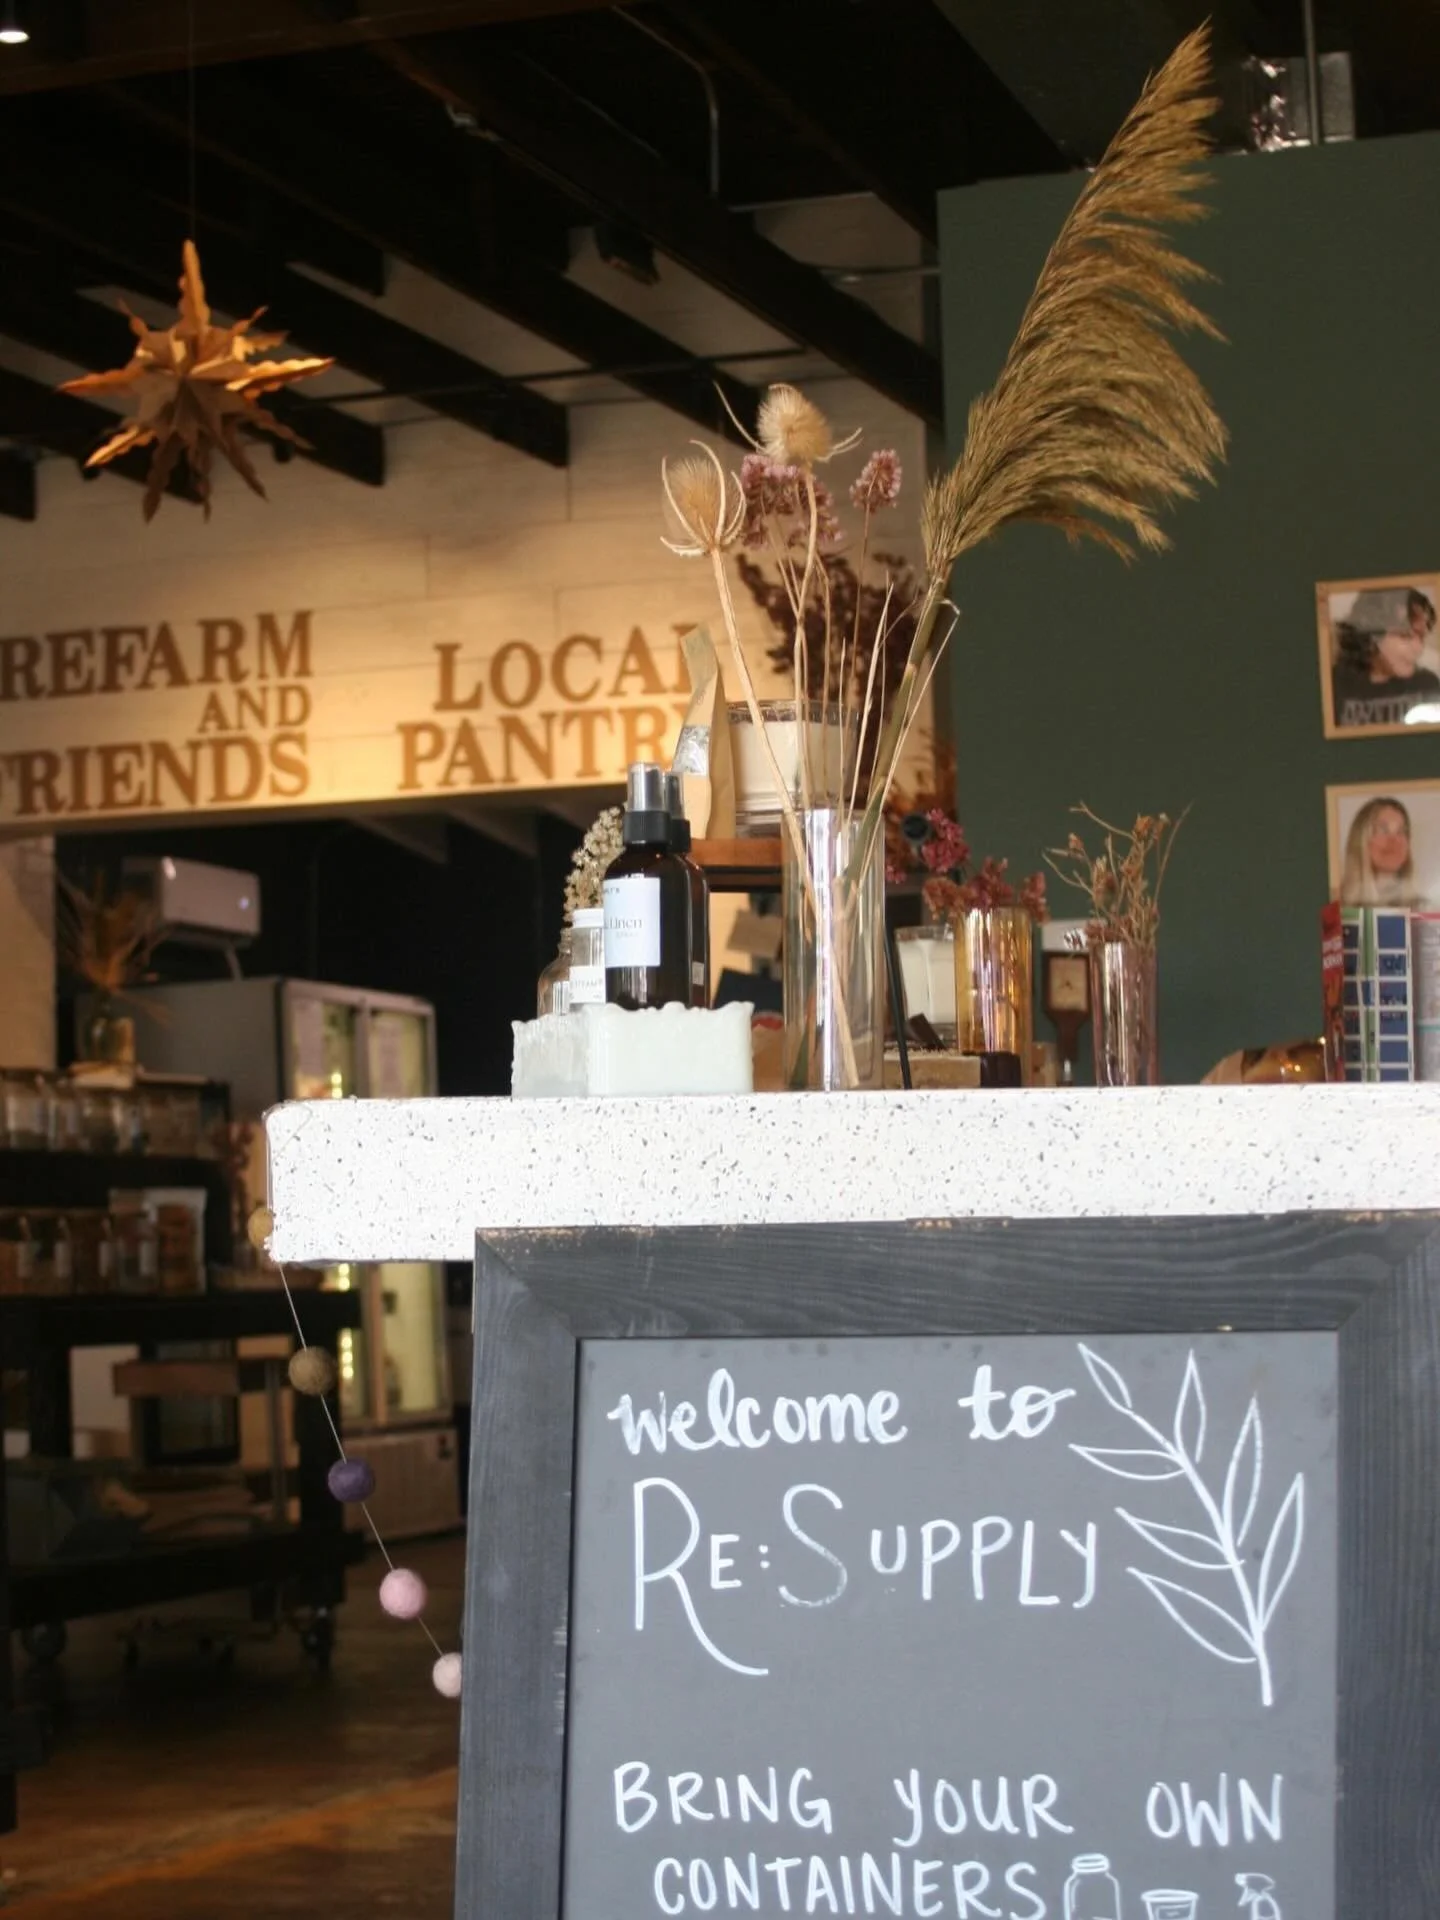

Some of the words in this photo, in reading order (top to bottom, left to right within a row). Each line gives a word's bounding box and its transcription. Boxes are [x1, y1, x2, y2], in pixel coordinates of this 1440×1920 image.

[0, 610, 313, 702] REFARM
[197, 684, 312, 733] AND
[396, 702, 691, 790] PANTR
[607, 1367, 908, 1455] welcome
[958, 1364, 1077, 1441] to
[613, 1761, 833, 1834] BRING
[893, 1768, 1075, 1847] YOUR
[1146, 1772, 1283, 1847] OWN
[653, 1852, 1047, 1920] CONTAINERS
